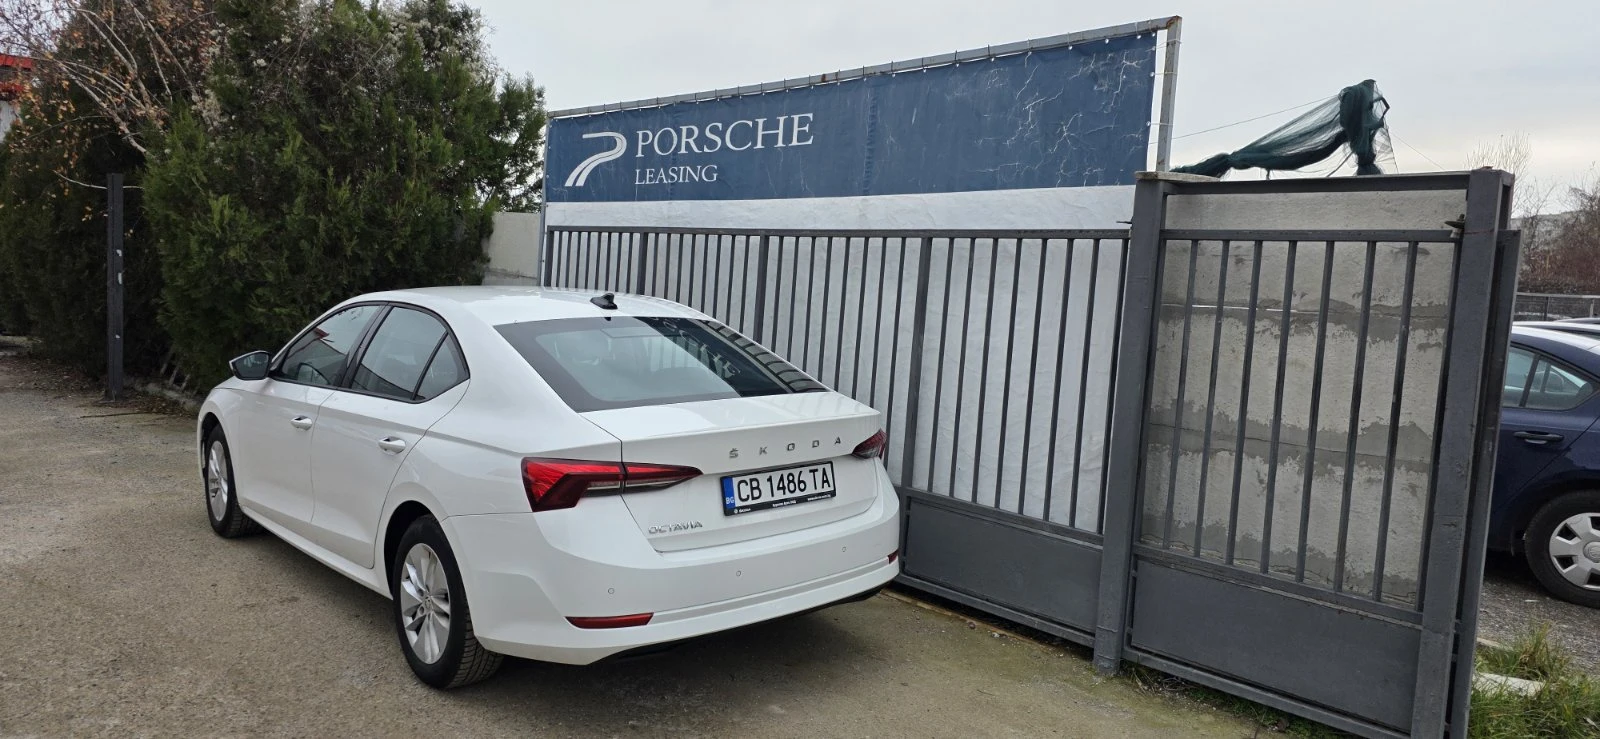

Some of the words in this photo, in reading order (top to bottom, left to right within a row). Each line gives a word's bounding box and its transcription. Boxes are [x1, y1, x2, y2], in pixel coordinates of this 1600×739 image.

[635, 112, 814, 158] PORSCHE
[635, 164, 718, 185] LEASING
[729, 437, 841, 458] ŠKODA
[737, 477, 762, 502] CB
[766, 470, 807, 498] 1486
[809, 467, 831, 490] TA
[725, 496, 735, 505] BG
[648, 520, 703, 535] OCTAVIA
